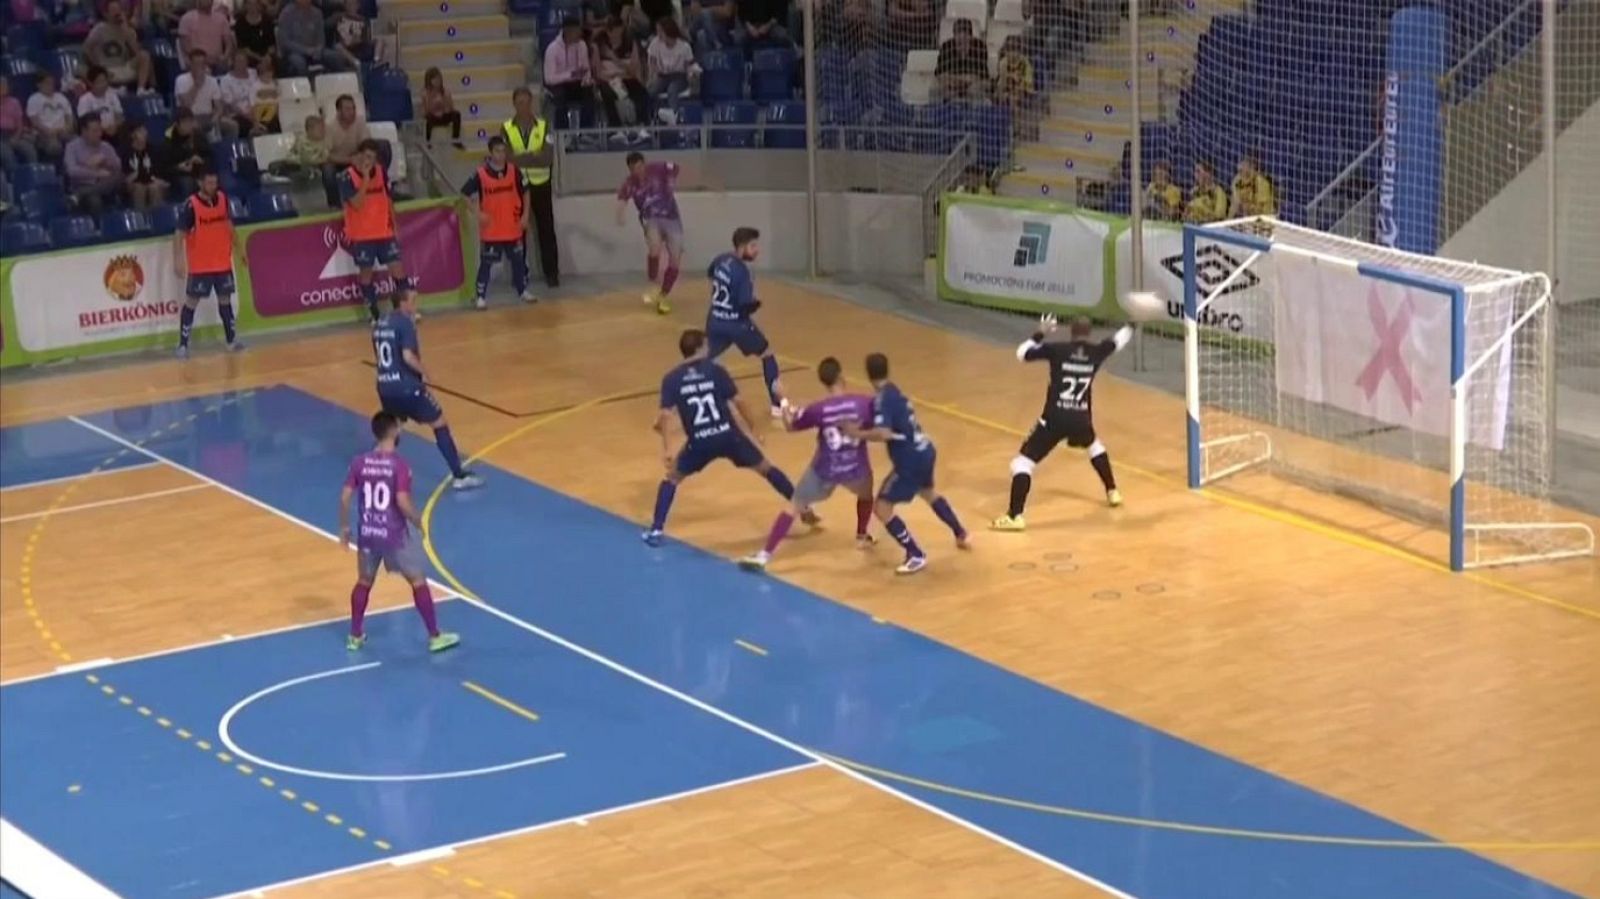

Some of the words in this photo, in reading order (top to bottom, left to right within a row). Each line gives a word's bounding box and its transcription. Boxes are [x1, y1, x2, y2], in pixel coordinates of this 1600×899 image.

[79, 300, 179, 328] BIERKÖNIG
[1059, 376, 1092, 400] 27
[686, 392, 721, 426] 21
[363, 480, 391, 511] 10
